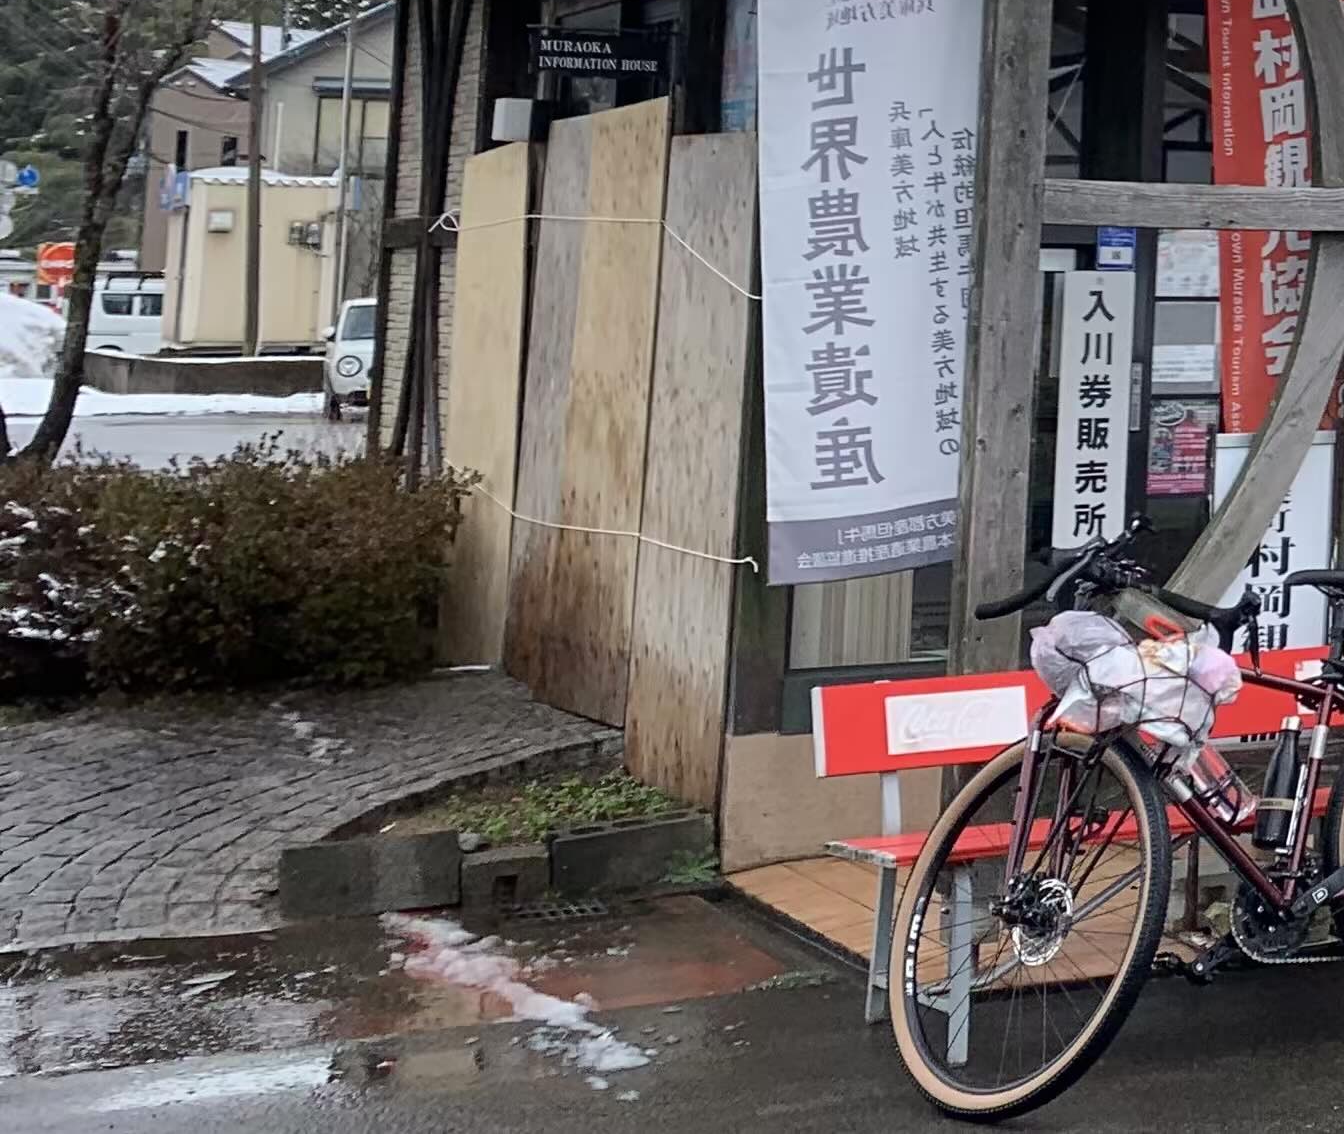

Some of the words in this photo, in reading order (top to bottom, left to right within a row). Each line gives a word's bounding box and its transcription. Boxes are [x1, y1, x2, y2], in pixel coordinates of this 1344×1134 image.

[538, 55, 617, 70] INFORMATION
[621, 59, 658, 72] HOUSE
[540, 39, 612, 54] MURAOKA
[1221, 18, 1234, 68] Tourist
[1221, 72, 1235, 156] Information
[1230, 232, 1244, 263] own
[1231, 268, 1245, 332] Muraoka
[1231, 338, 1244, 395] Tourism
[1072, 290, 1115, 537] 入川券販売所
